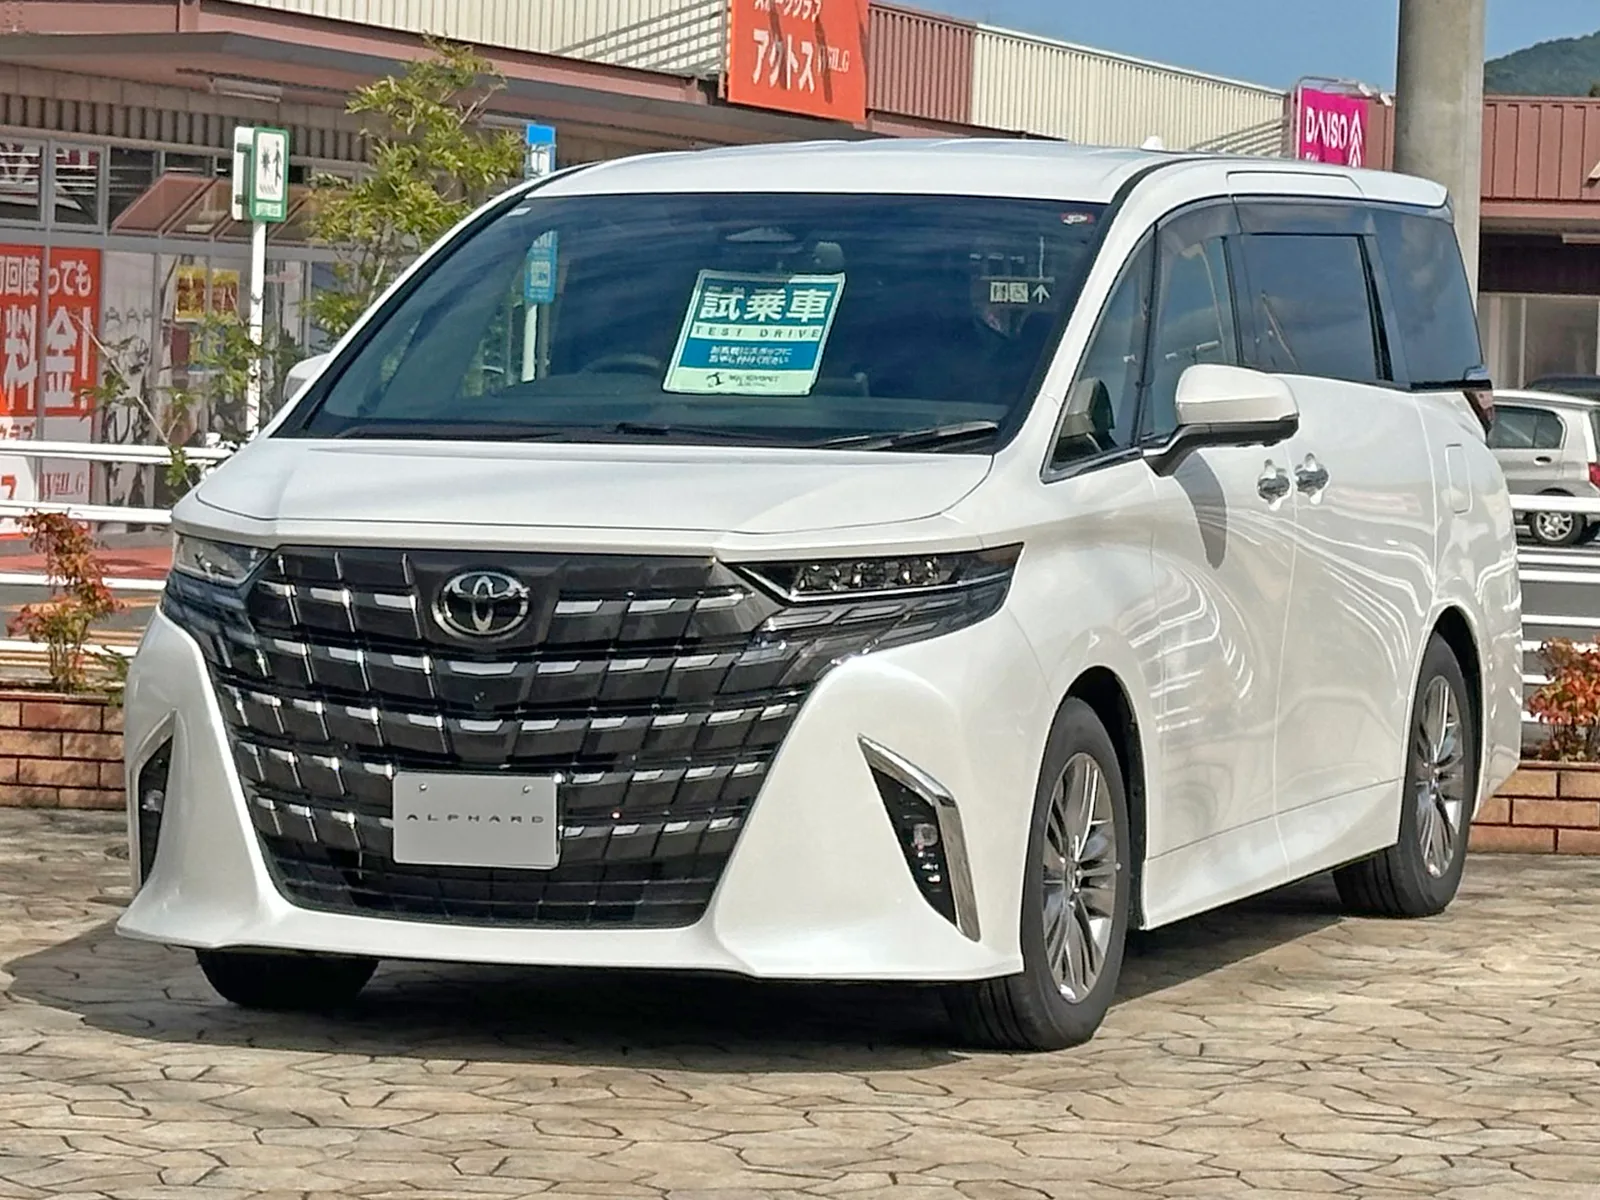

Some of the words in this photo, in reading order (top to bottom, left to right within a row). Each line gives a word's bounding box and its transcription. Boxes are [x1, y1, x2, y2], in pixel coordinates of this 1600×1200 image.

[752, 28, 815, 94] アクトス
[1305, 105, 1348, 151] DAISO
[0, 255, 92, 297] 回使っても
[699, 285, 832, 323] 試乗車
[693, 326, 744, 338] TEST
[759, 328, 821, 339] DRIVE
[406, 814, 544, 824] ALPHARD
